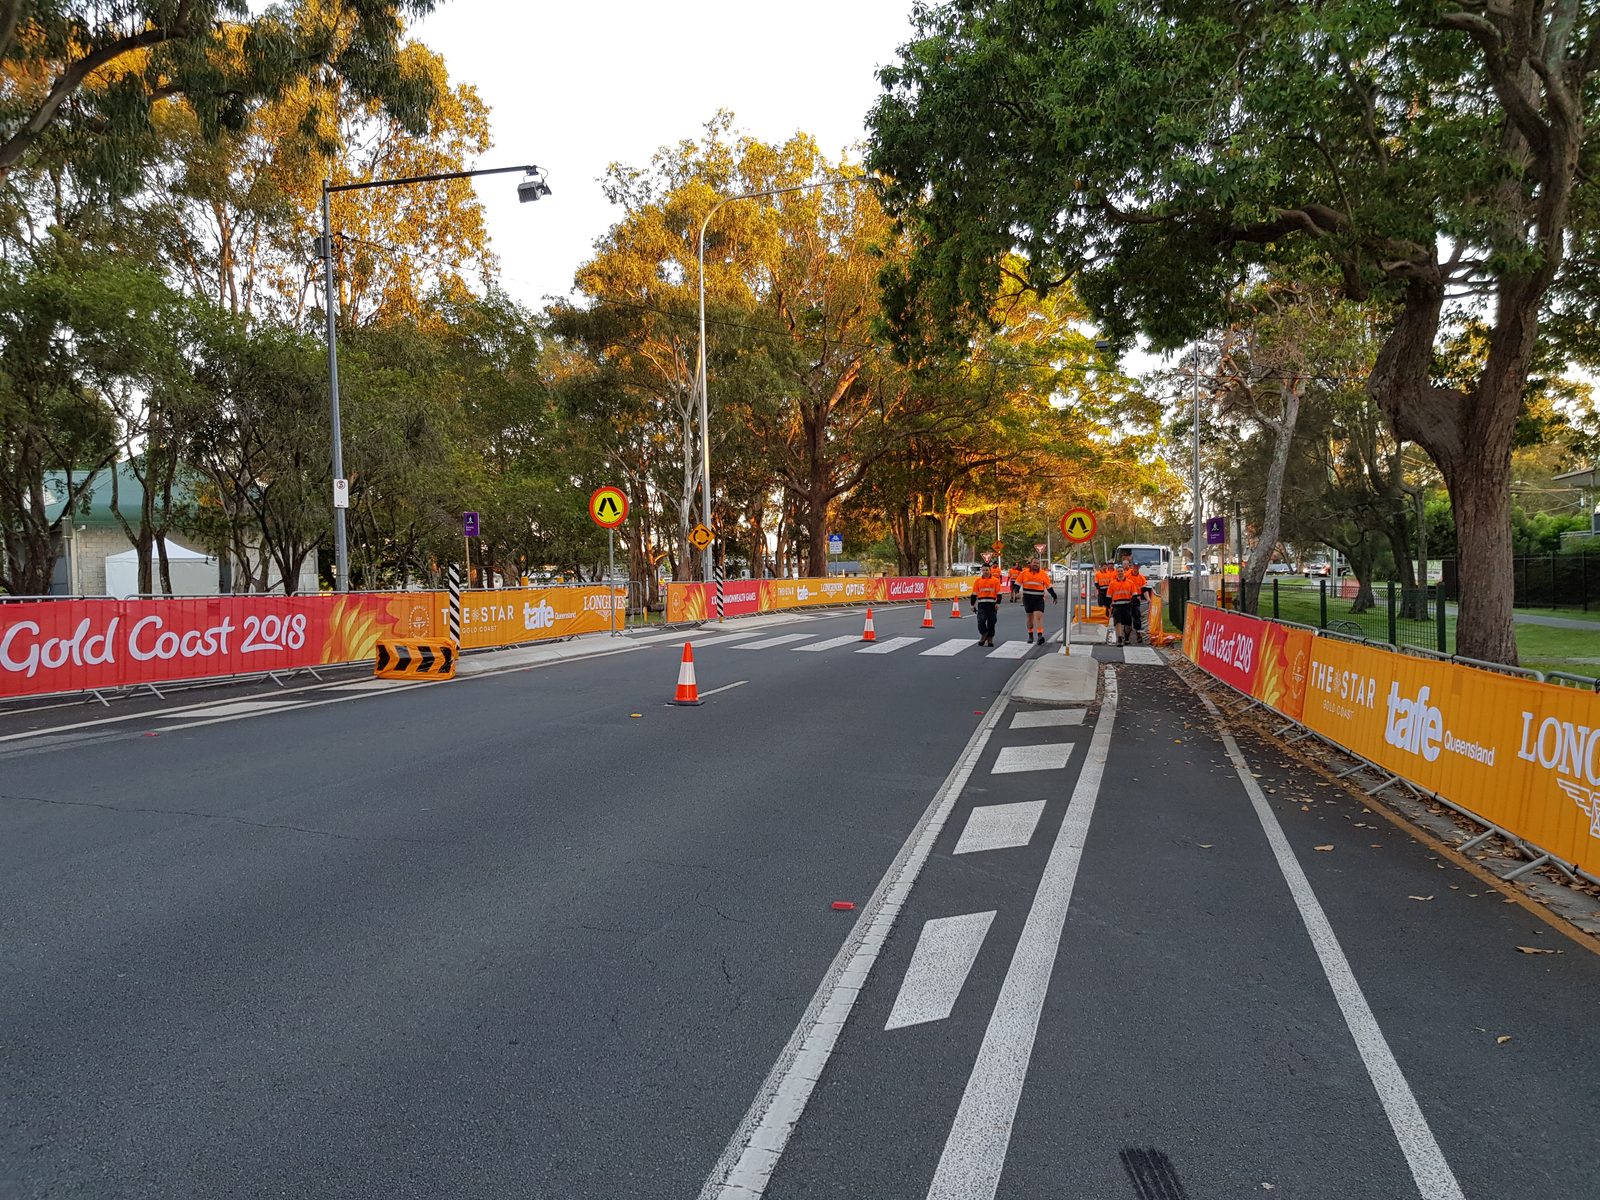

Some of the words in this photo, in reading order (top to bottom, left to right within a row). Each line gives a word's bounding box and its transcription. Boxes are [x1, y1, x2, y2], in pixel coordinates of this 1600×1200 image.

[845, 584, 865, 596] OPTUS
[441, 607, 471, 625] TE
[481, 604, 515, 623] STAR
[523, 599, 555, 630] tafe
[0, 617, 120, 678] Gold
[128, 615, 236, 661] Coast
[240, 613, 307, 654] 2018
[1203, 620, 1220, 656] Gold
[1216, 624, 1235, 665] Coast
[1234, 633, 1253, 674] 2018
[1311, 661, 1334, 693] THE
[1340, 670, 1377, 710] STAR
[1385, 681, 1443, 762] tafe
[1444, 730, 1496, 767] Queensland
